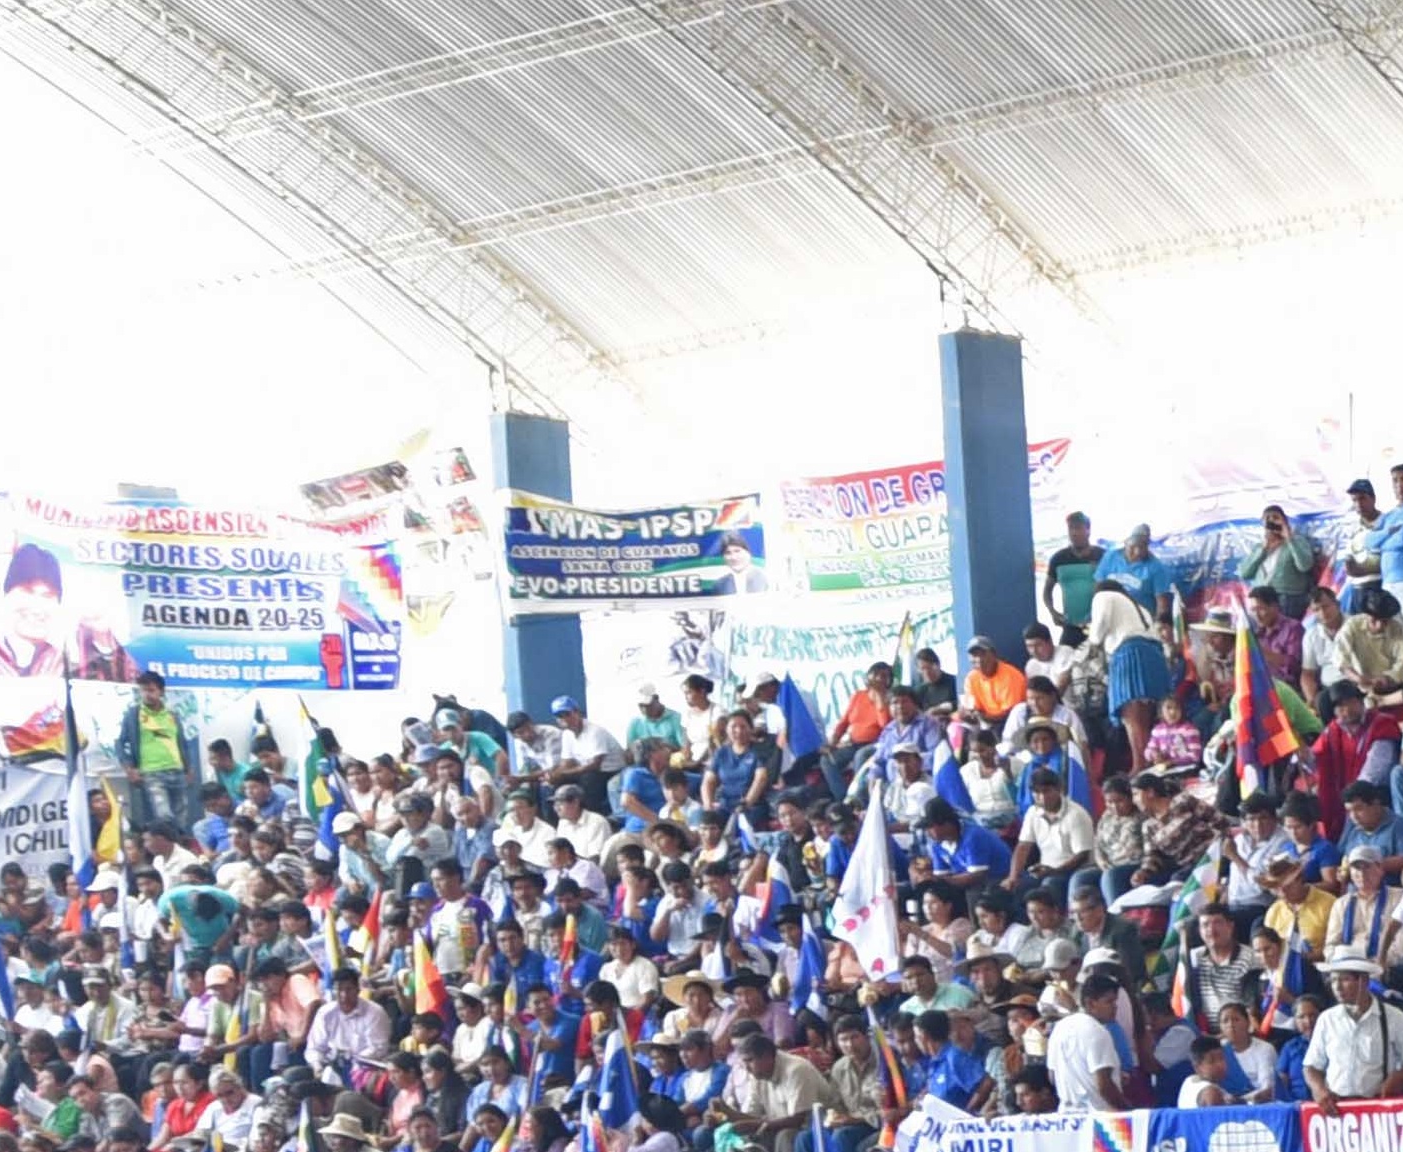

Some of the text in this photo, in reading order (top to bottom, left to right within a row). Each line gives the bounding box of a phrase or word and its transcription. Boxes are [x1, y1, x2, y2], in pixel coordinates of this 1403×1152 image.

[77, 539, 222, 568] SECTORES
[142, 604, 324, 630] AGENDA 20-25
[5, 829, 69, 856] ICHIL
